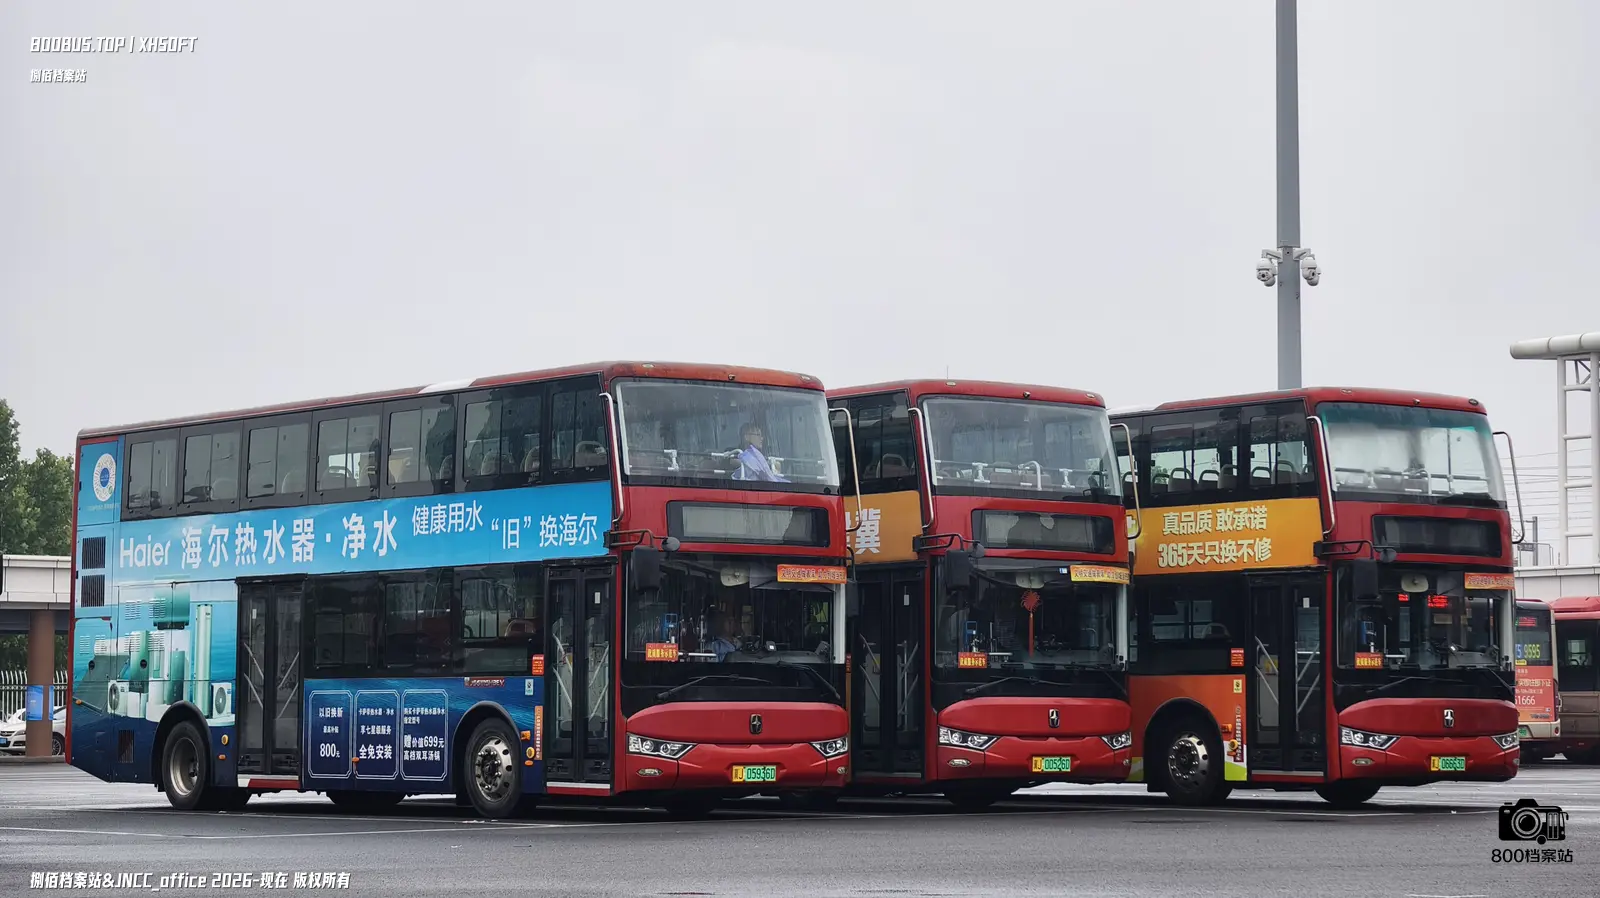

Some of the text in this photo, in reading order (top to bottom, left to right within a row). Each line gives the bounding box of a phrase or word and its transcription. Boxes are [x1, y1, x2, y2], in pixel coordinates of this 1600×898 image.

[412, 500, 483, 536] 健康用水
[846, 508, 881, 555] 冀
[1163, 505, 1268, 535] 真品质 敢承诺
[119, 535, 171, 569] Haier
[1158, 537, 1272, 568] 365天只换不修
[319, 706, 343, 718] 以旧换新
[320, 743, 341, 758] 800元
[359, 743, 393, 760] 全免安装
[404, 750, 441, 761] 高档双耳汤锅
